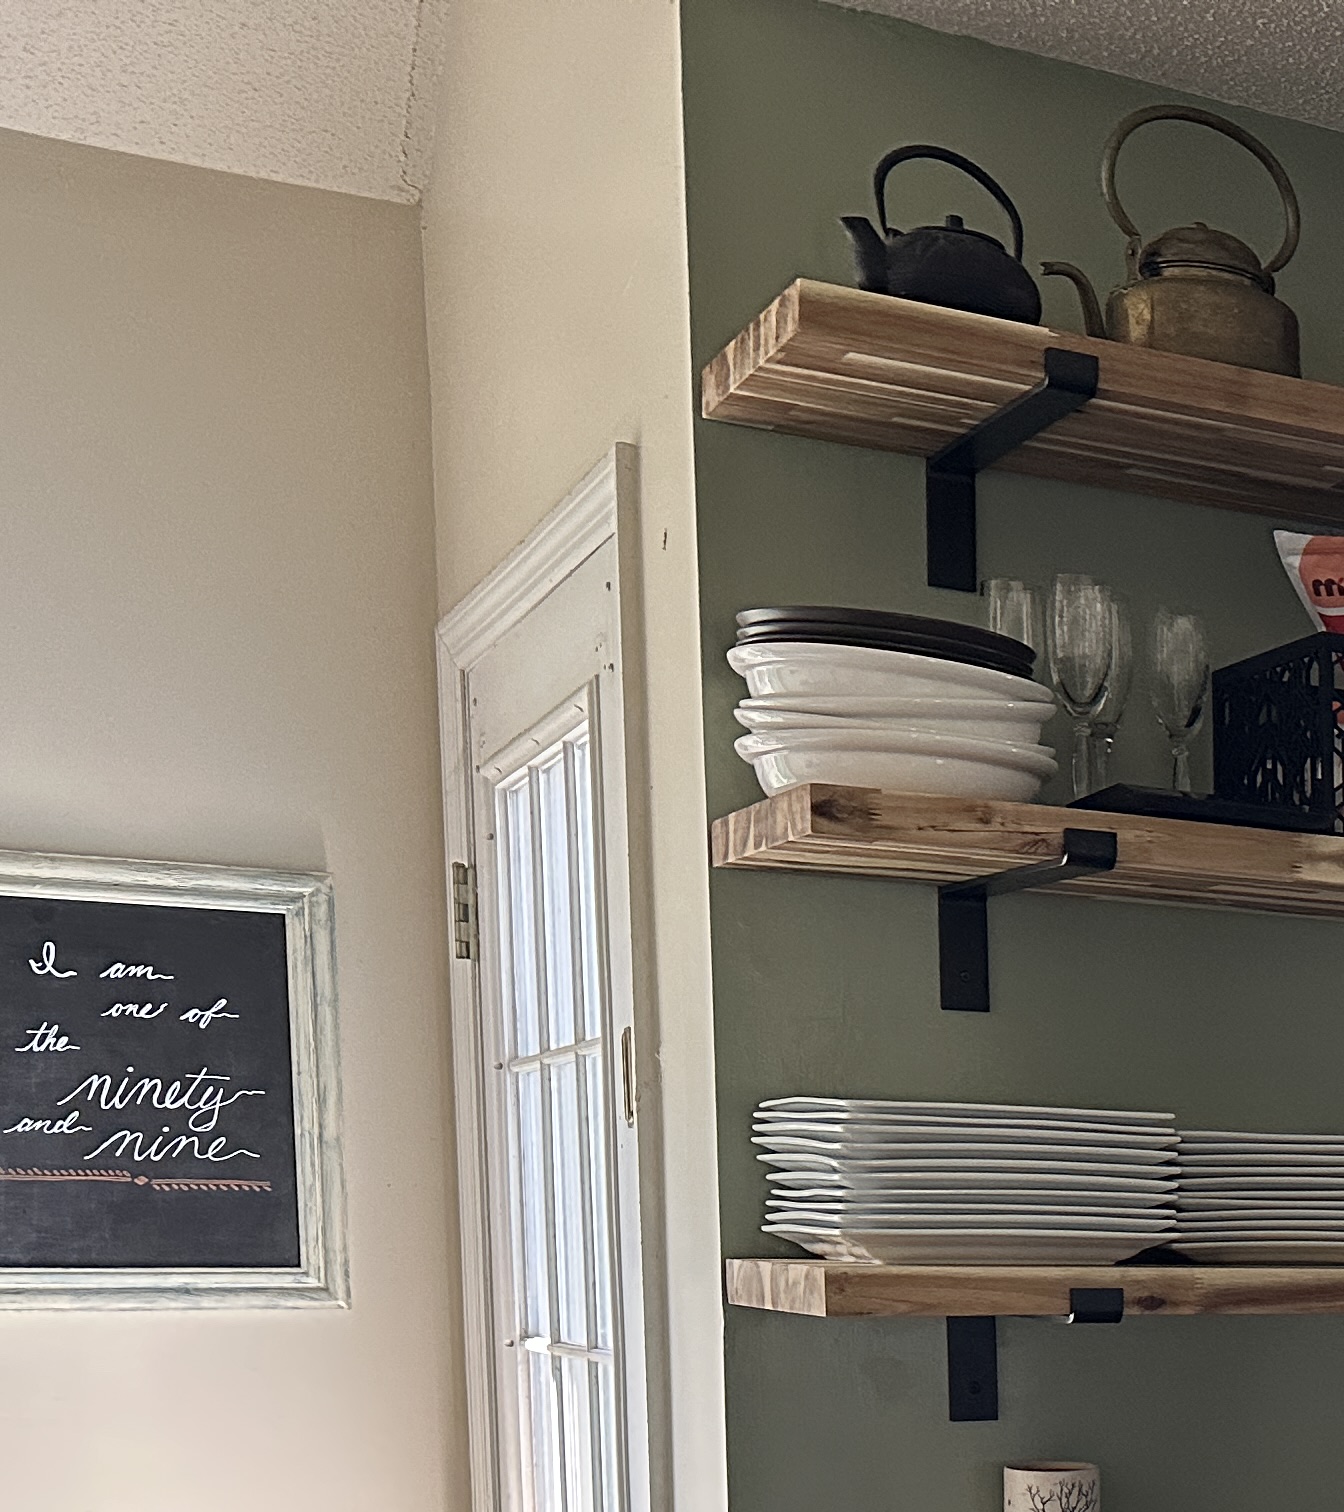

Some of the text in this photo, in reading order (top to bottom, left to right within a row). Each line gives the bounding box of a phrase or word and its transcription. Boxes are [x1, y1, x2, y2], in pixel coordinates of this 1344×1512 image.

[28, 941, 175, 980] I am
[100, 998, 240, 1029] one of
[14, 1021, 81, 1052] the
[56, 1066, 266, 1132] ninety
[2, 1111, 261, 1162] and nine
